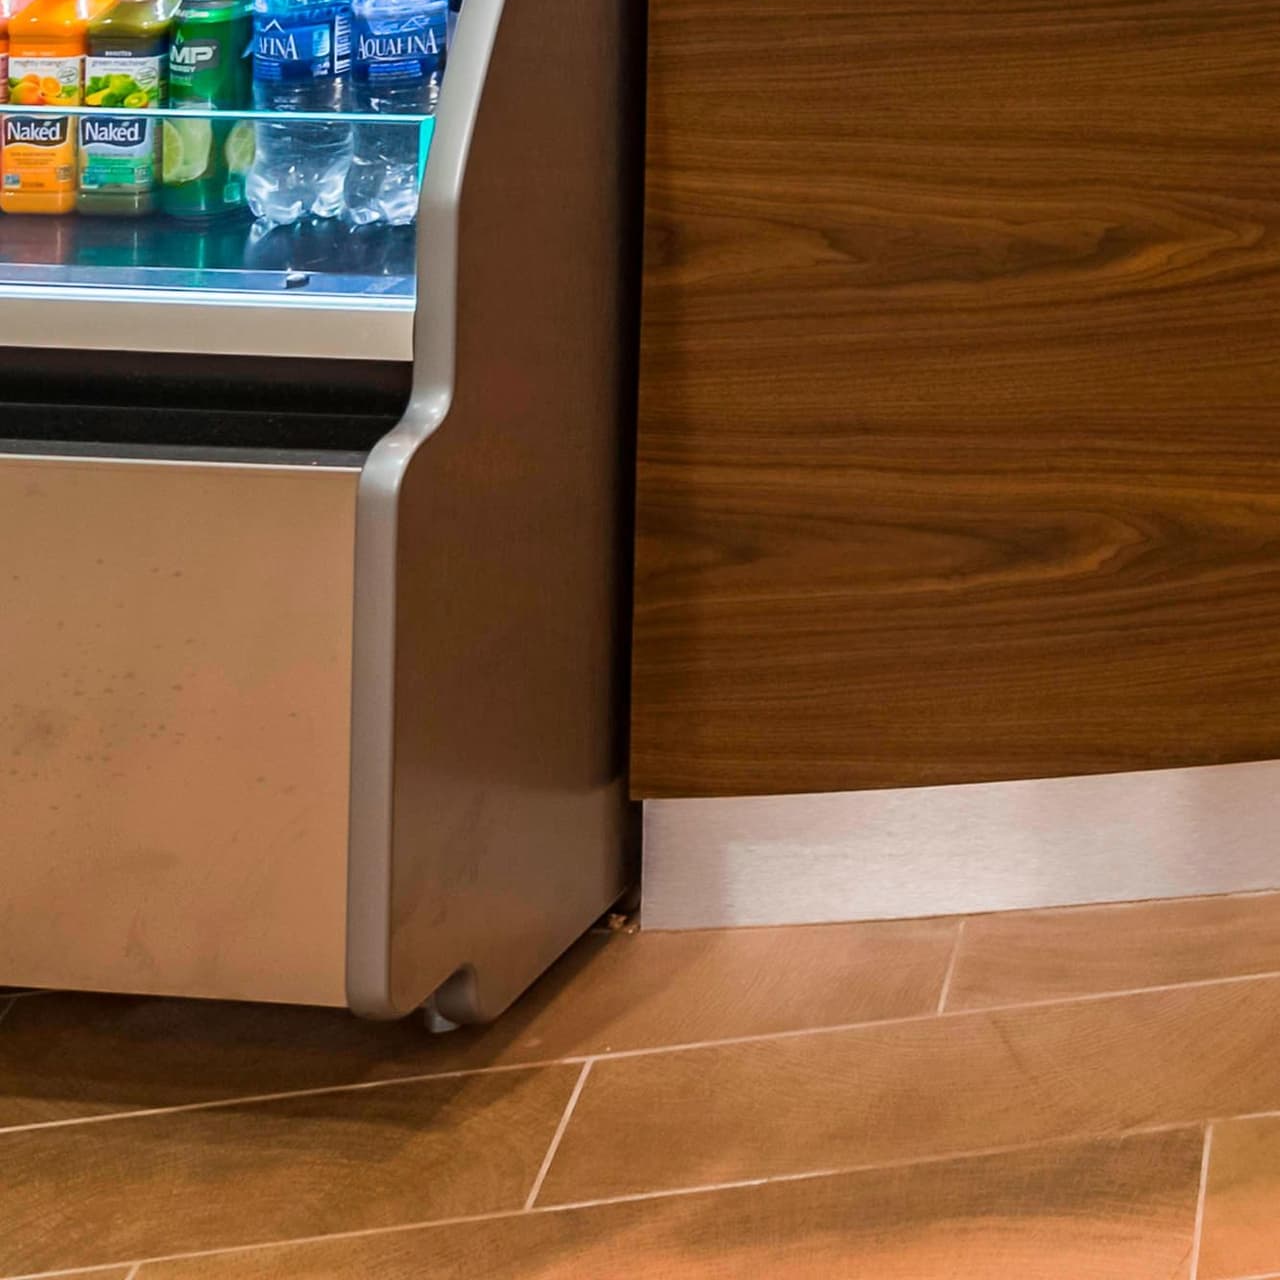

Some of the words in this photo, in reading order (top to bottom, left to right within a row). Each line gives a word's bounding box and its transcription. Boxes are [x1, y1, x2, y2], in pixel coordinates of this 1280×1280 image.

[358, 28, 440, 60] AQUAFINA
[170, 45, 214, 64] MP
[7, 122, 61, 141] Naked
[85, 121, 139, 142] Naked
